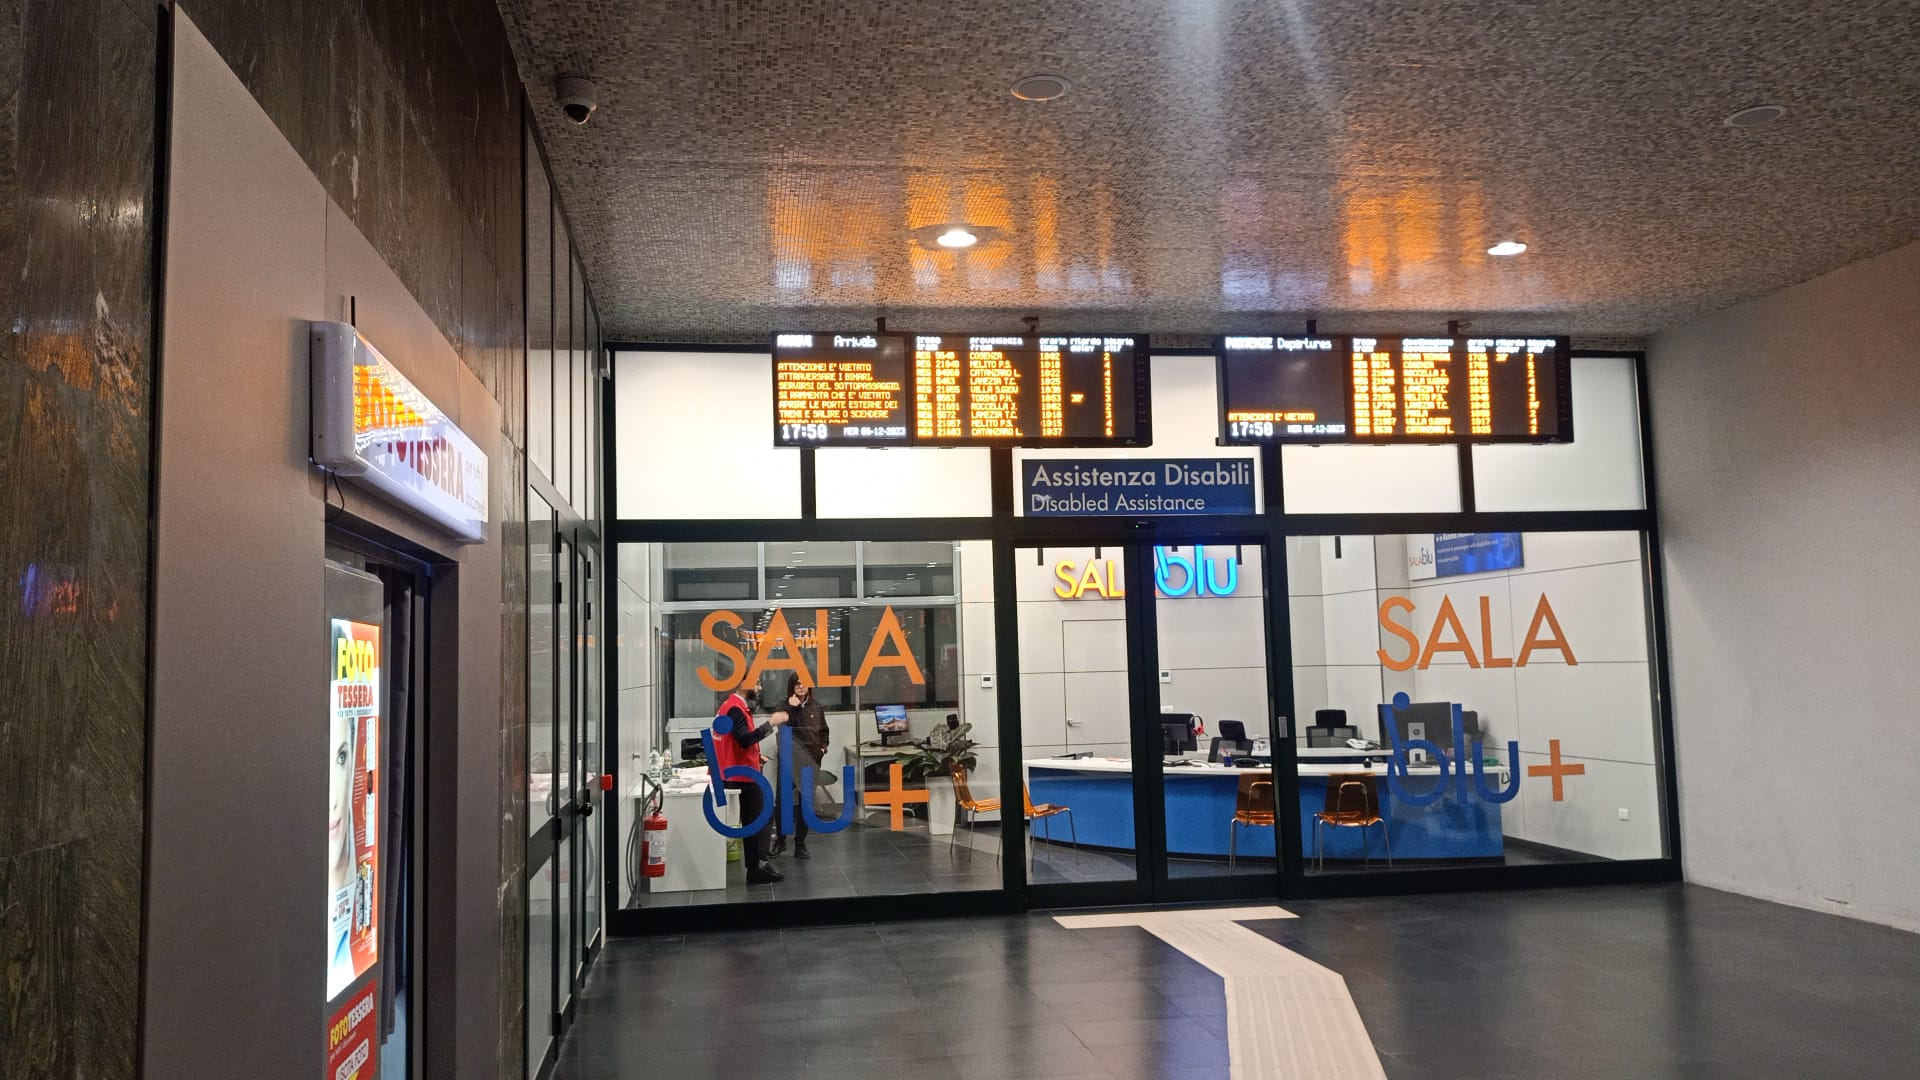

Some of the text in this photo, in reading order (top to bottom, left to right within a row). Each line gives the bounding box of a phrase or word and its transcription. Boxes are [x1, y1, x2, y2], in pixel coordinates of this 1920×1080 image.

[834, 336, 876, 347] Arrivals
[1278, 338, 1332, 351] Departures
[839, 363, 871, 371] VIETATO
[970, 360, 996, 368] MELITO
[779, 382, 814, 390] SERVIRSI
[817, 382, 831, 390] DEL
[809, 401, 819, 409] LE
[822, 401, 846, 409] PORTE
[849, 401, 881, 409] ESTERNE
[885, 401, 897, 409] DEI
[805, 410, 810, 418] E
[813, 410, 840, 418] SALIRE
[851, 410, 889, 418] SCENDERE
[844, 427, 859, 435] MER
[1032, 462, 1249, 486] Assistenza Disabili
[1032, 493, 1205, 512] Disabled Assistance
[1154, 544, 1238, 596] blu
[1376, 592, 1578, 672] SALA
[695, 604, 925, 692] SALA
[337, 637, 374, 683] FOTO
[338, 685, 373, 708] TESSERA
